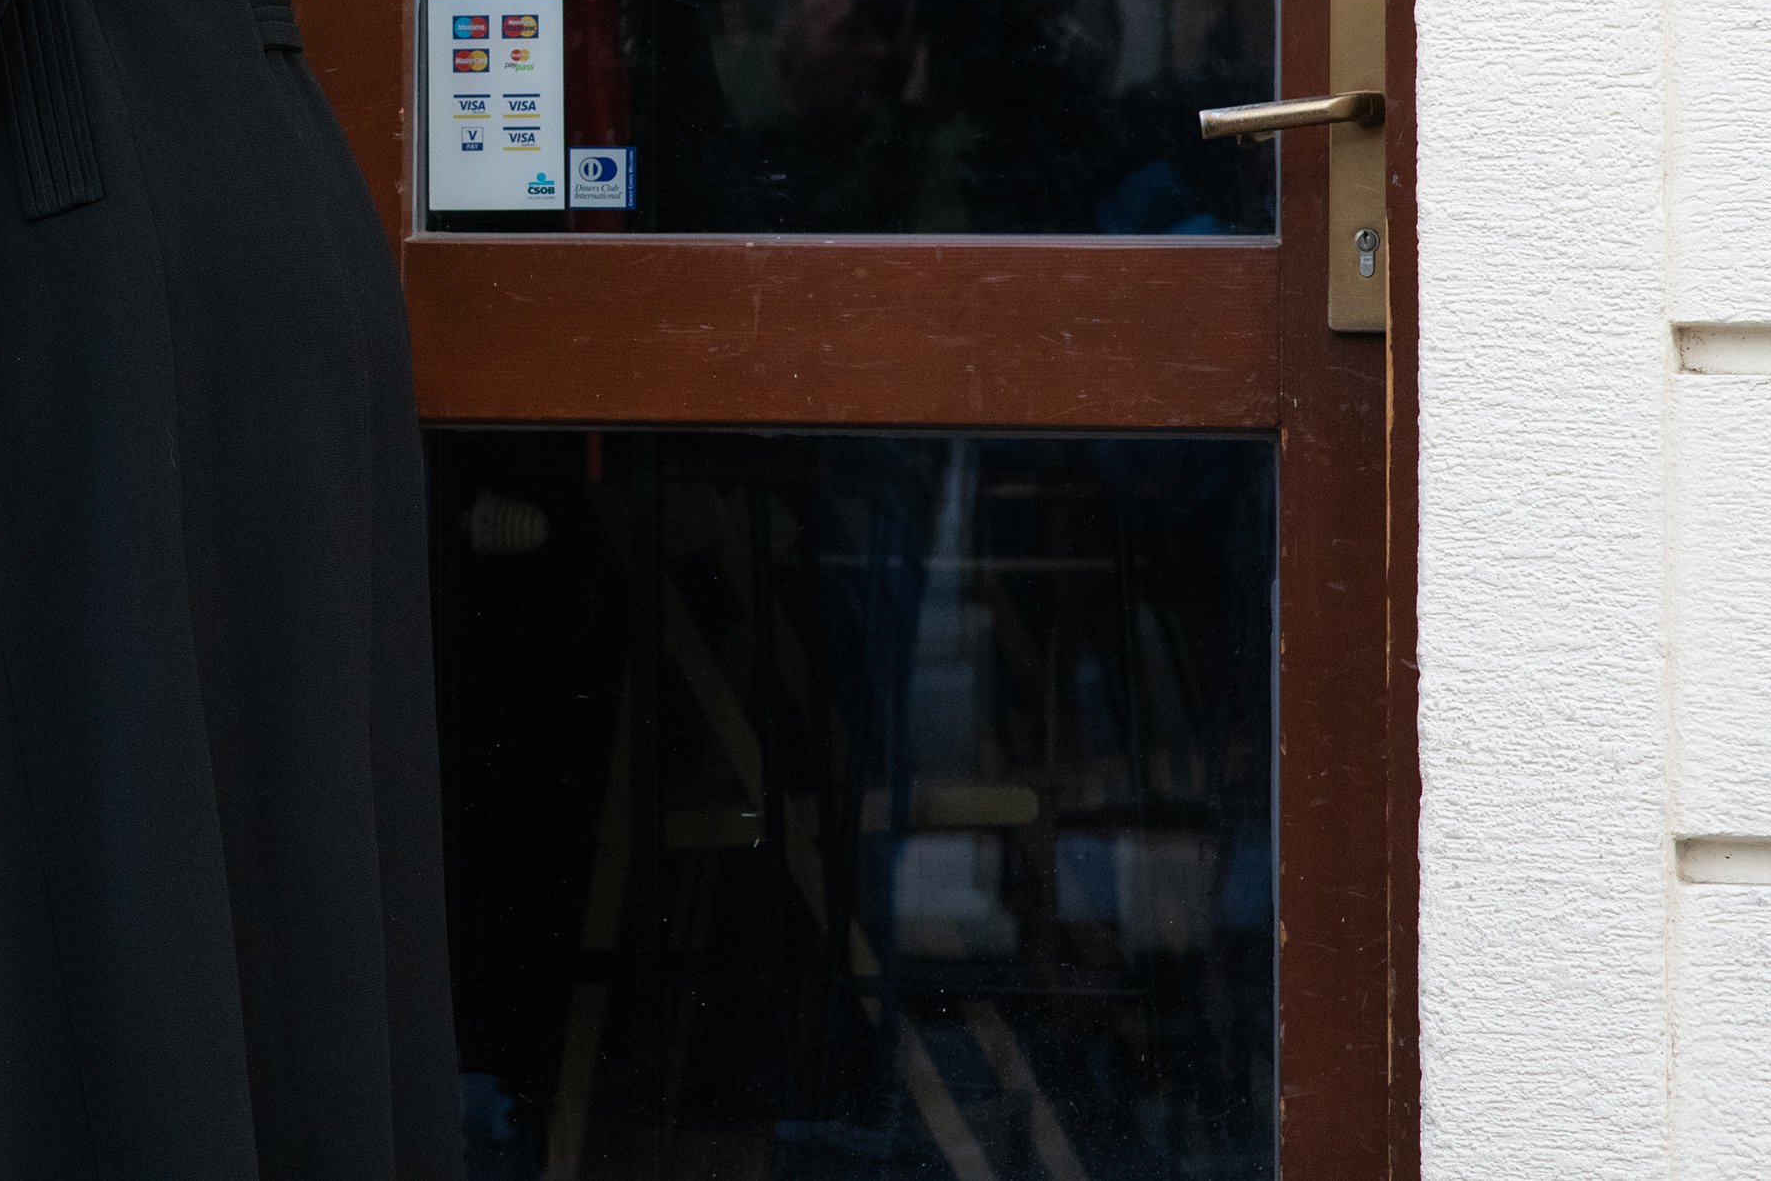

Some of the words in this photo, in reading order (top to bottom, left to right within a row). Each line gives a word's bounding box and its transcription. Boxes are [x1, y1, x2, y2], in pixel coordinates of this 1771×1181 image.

[459, 101, 486, 111] VISA
[508, 101, 536, 111] VISA
[467, 130, 478, 141] V
[508, 133, 536, 143] VISA
[528, 186, 555, 195] ČSOB
[575, 184, 600, 192] Diners
[601, 183, 619, 191] Club
[574, 191, 622, 200] International
